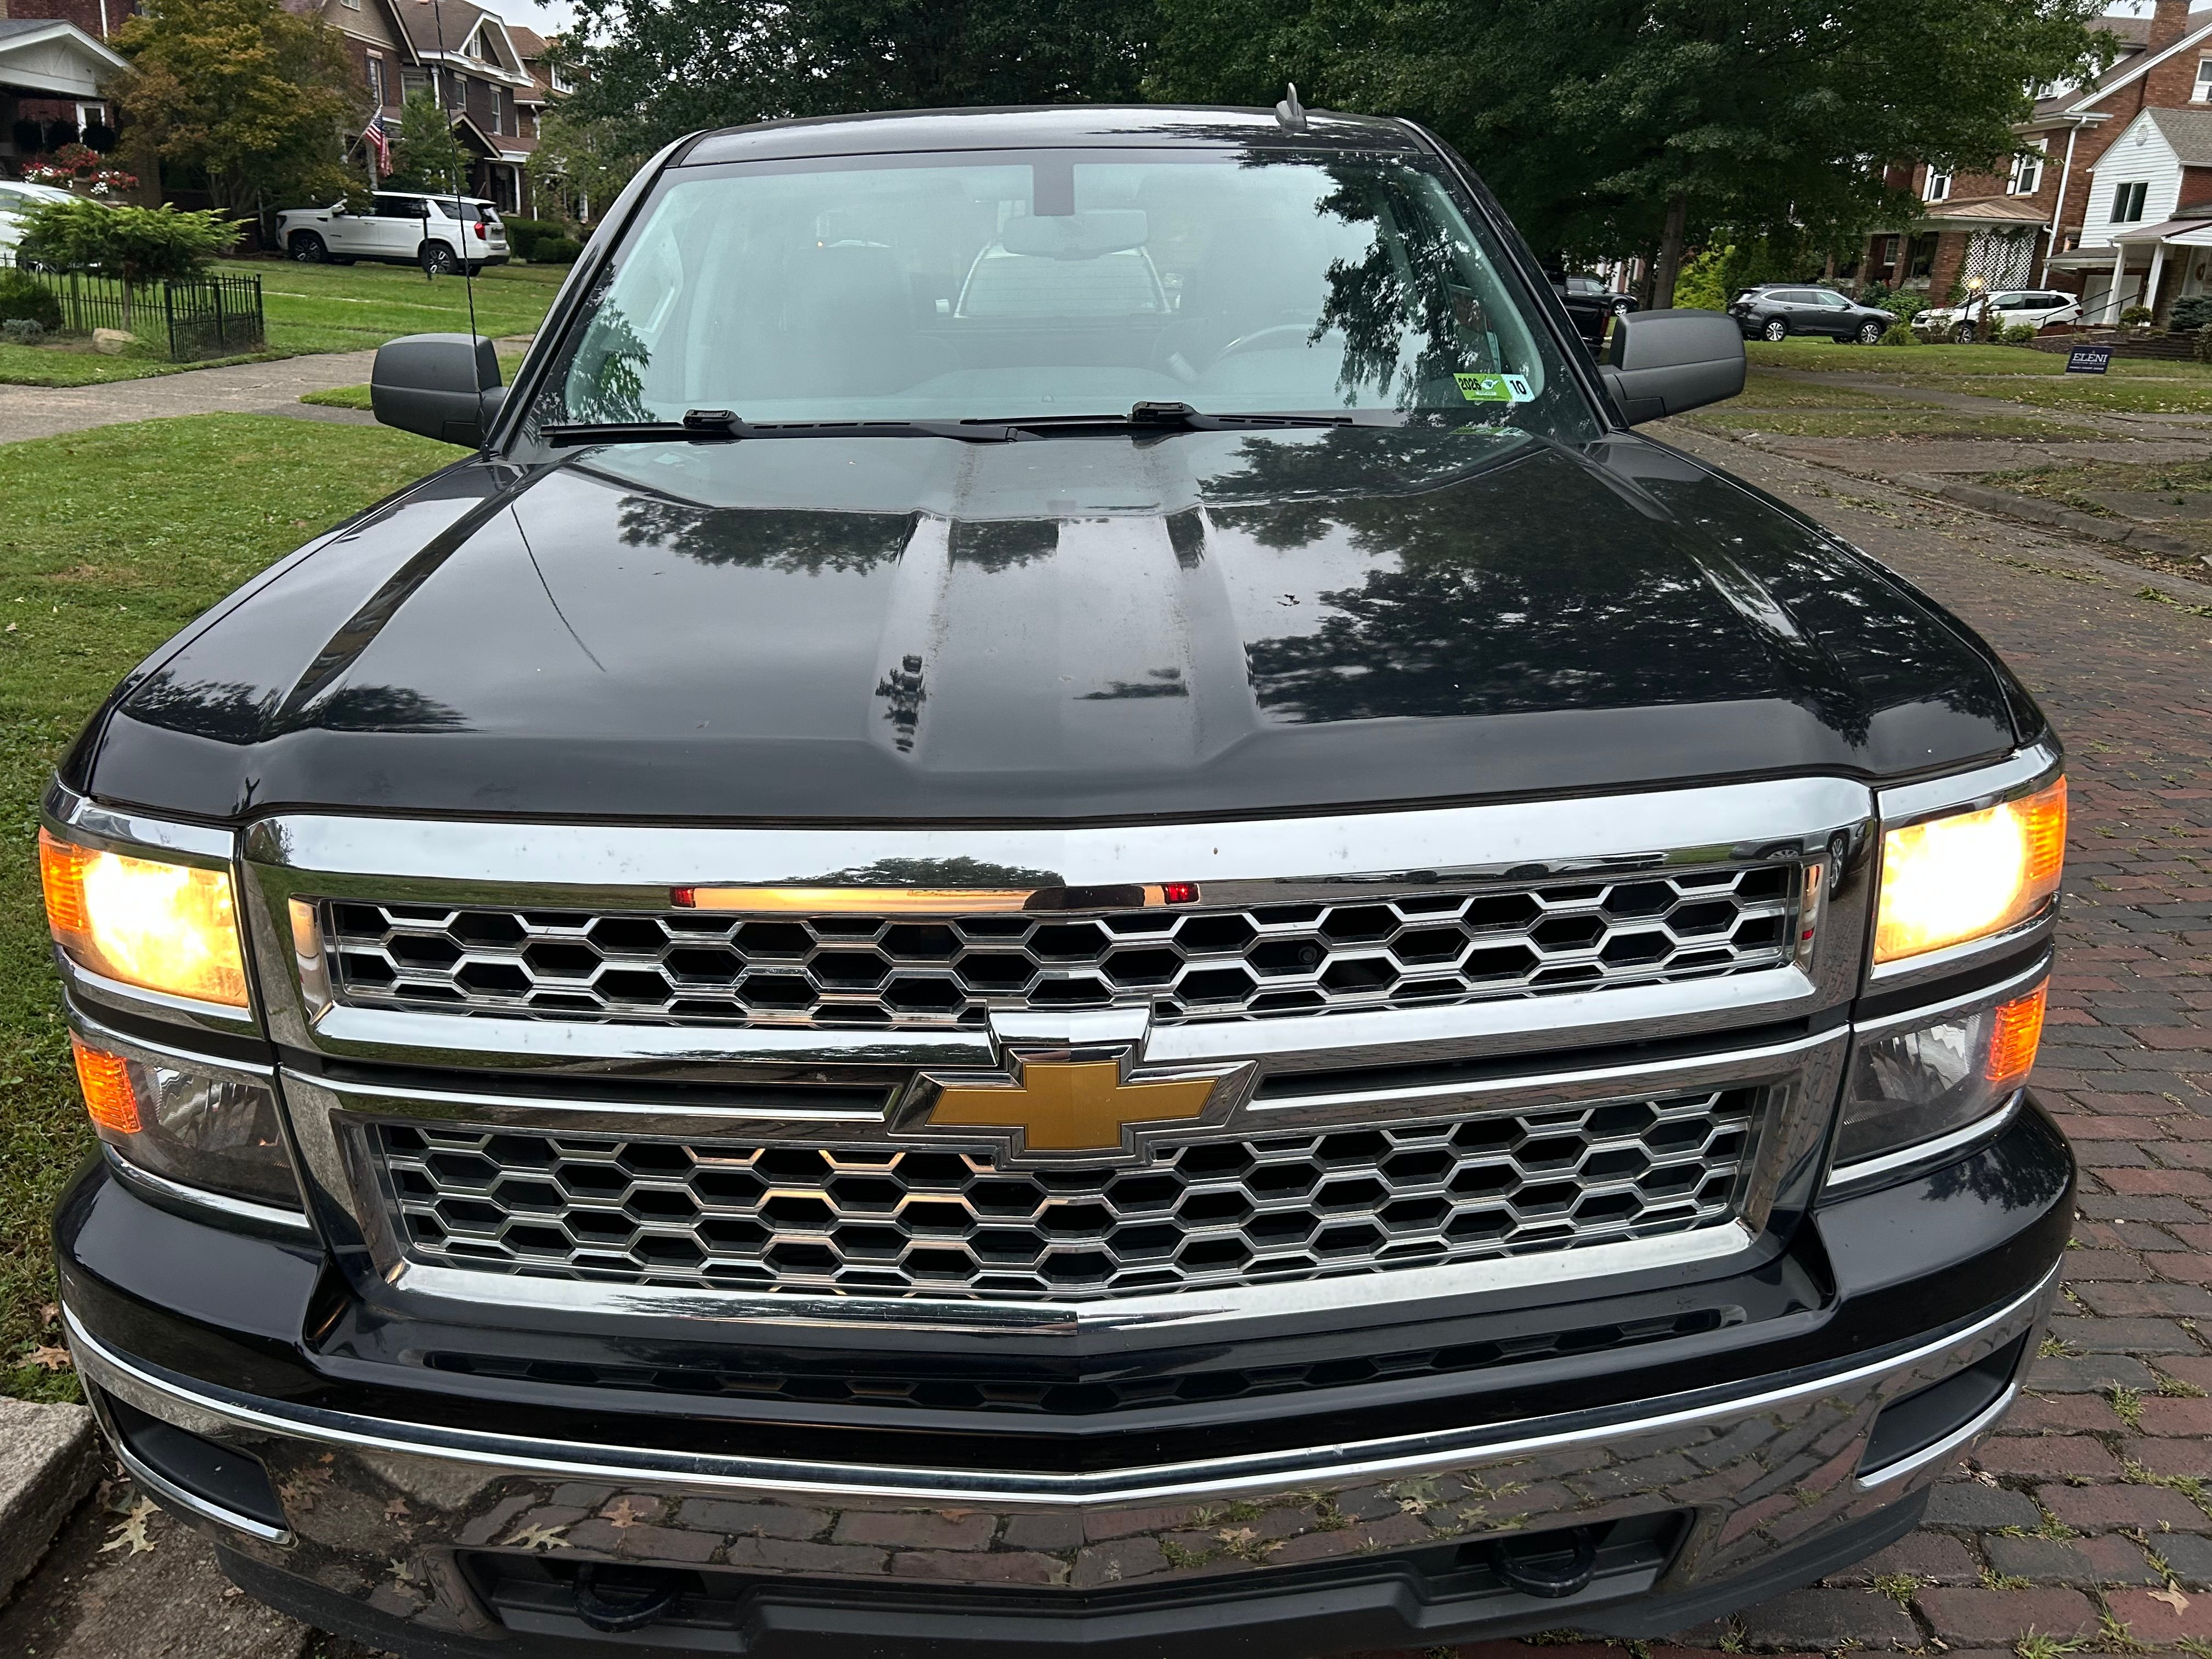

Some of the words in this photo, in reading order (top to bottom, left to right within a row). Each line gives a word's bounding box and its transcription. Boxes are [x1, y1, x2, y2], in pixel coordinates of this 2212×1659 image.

[2072, 353, 2108, 363] ELENI
[1458, 377, 1482, 391] 2026
[1509, 380, 1527, 395] 10
